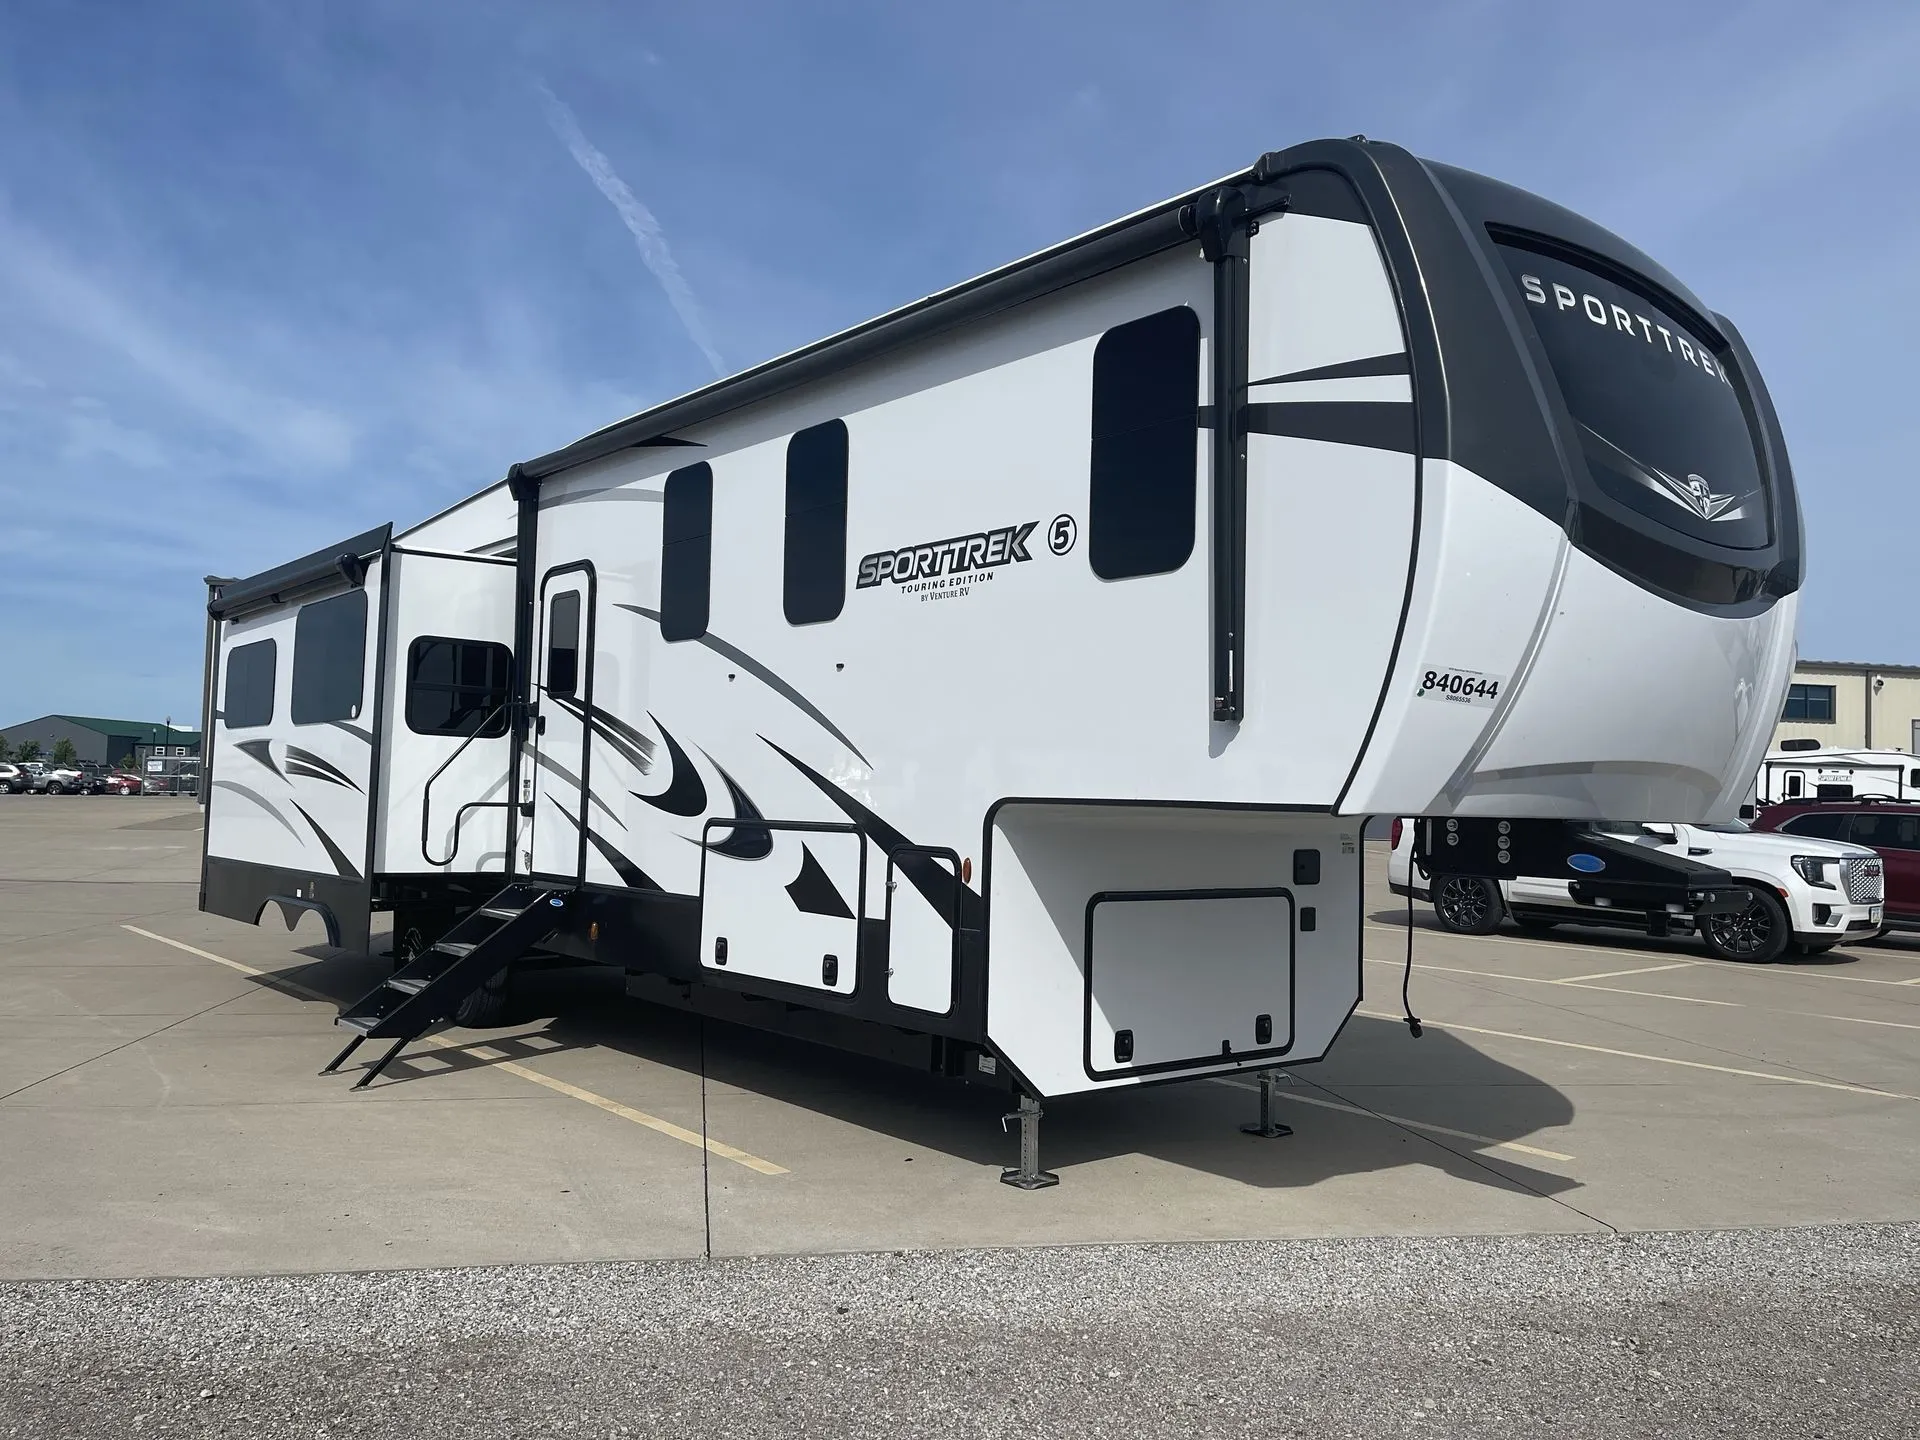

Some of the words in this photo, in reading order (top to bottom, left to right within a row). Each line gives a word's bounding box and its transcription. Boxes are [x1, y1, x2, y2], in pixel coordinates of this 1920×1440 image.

[1521, 274, 1734, 389] SPORTTREK
[856, 520, 1040, 589] SPORTTREK
[901, 579, 946, 594] TOURING
[949, 572, 994, 587] EDITION
[959, 587, 970, 597] RV
[1422, 671, 1499, 699] 840644
